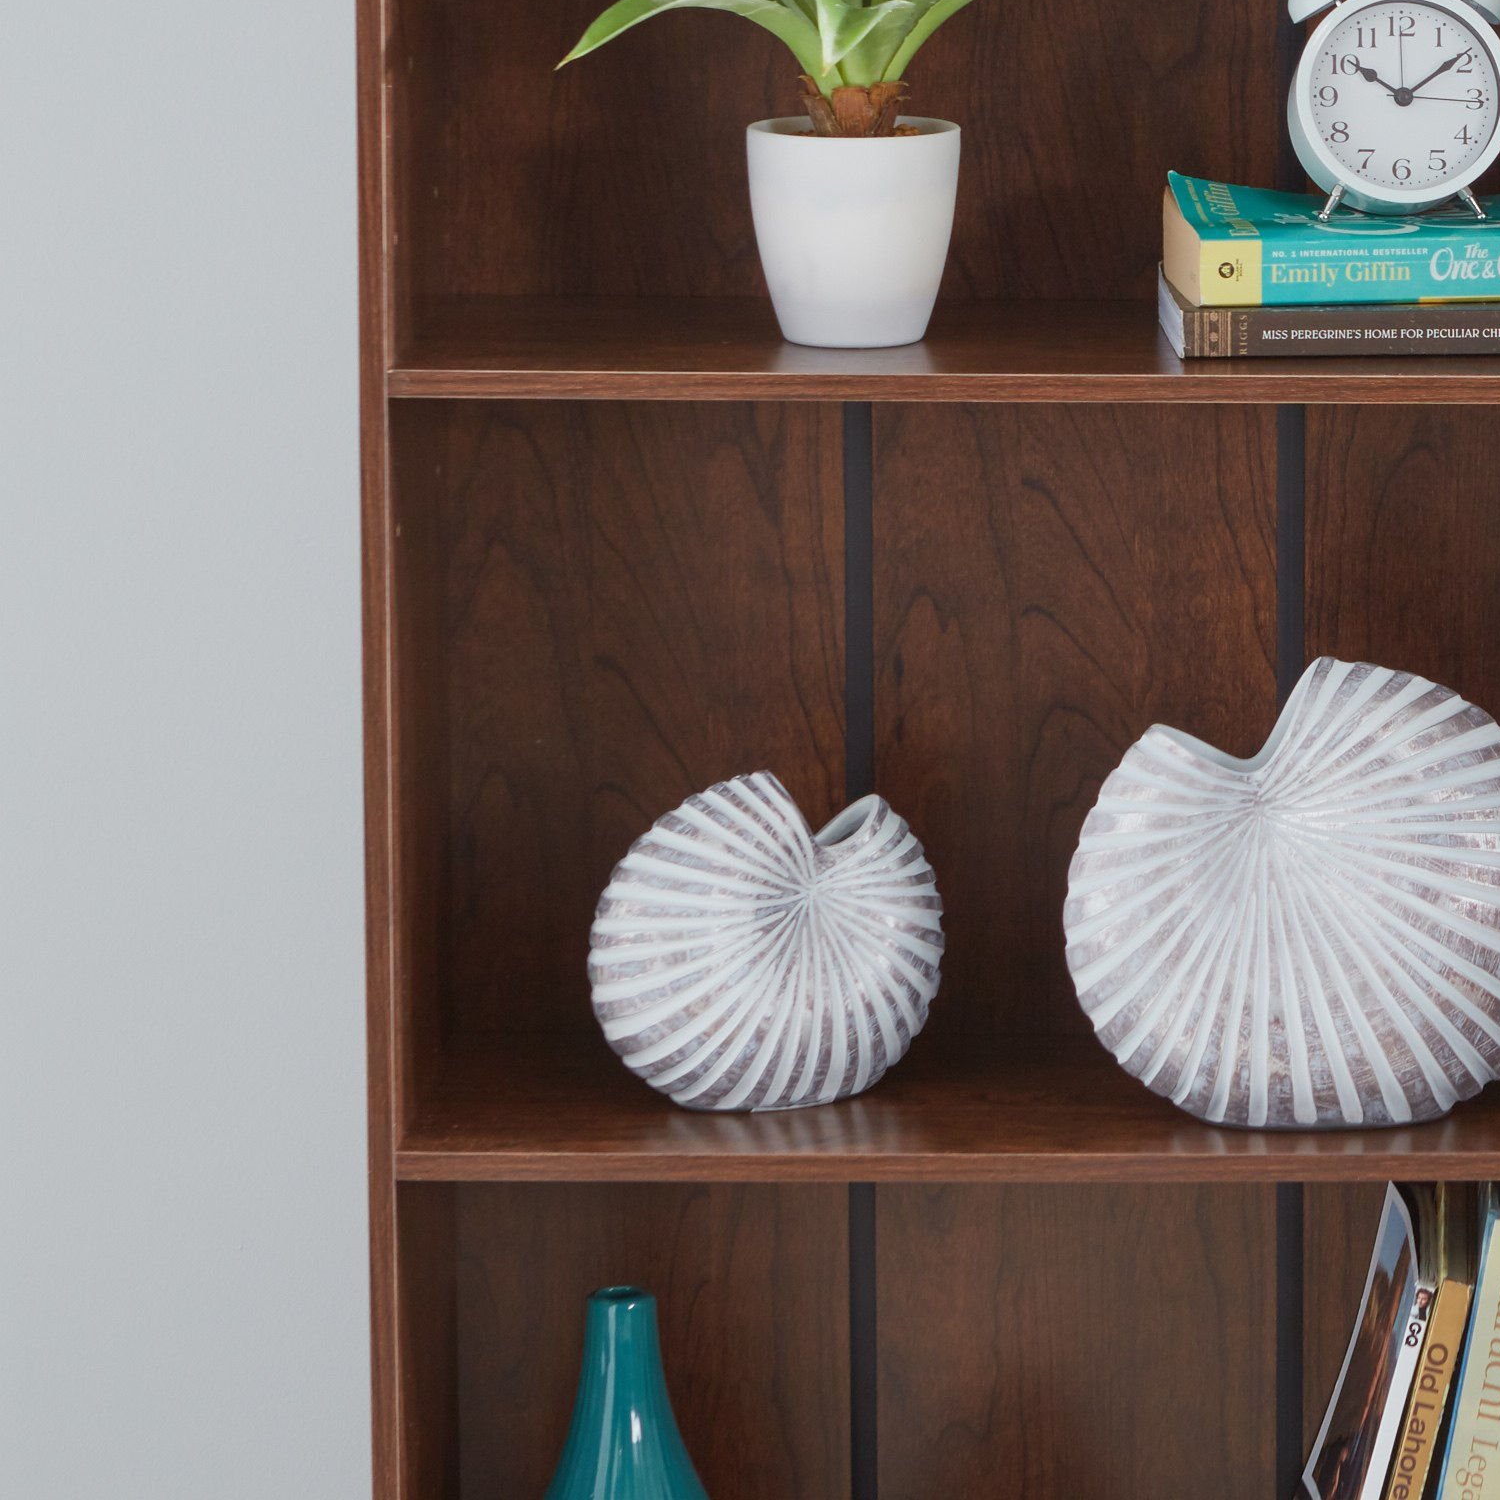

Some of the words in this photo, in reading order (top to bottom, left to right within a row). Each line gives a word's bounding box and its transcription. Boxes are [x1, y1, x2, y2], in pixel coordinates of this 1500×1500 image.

[1388, 16, 1416, 37] 12
[1434, 27, 1443, 47] 1
[1357, 28, 1378, 48] 11
[1331, 54, 1360, 75] 10
[1456, 53, 1474, 73] 2
[1319, 86, 1338, 107] 9
[1465, 89, 1484, 110] 3
[1330, 121, 1350, 143] 8
[1454, 124, 1472, 145] 4
[1357, 149, 1375, 170] 7
[1392, 159, 1411, 180] 6
[1428, 150, 1447, 171] 5
[1272, 250, 1287, 258] NO.
[1290, 250, 1297, 258] 1
[1300, 248, 1370, 257] INTERNATIONAL
[1373, 247, 1429, 256] BESTSELLER
[1464, 242, 1489, 259] The
[1271, 262, 1339, 288] Emily
[1345, 261, 1411, 282] Giffin
[1429, 247, 1480, 281] One
[1482, 260, 1496, 279] &
[1239, 314, 1248, 355] RIGGS
[1262, 329, 1288, 340] MISS
[1291, 329, 1362, 340] PEREGRINE'S
[1364, 328, 1398, 339] HOME
[1400, 328, 1423, 339] FOR
[1426, 328, 1480, 339] PECULIAR
[1404, 1322, 1422, 1347] GQ
[1418, 1343, 1449, 1394] Old
[1393, 1401, 1435, 1500] Lahore
